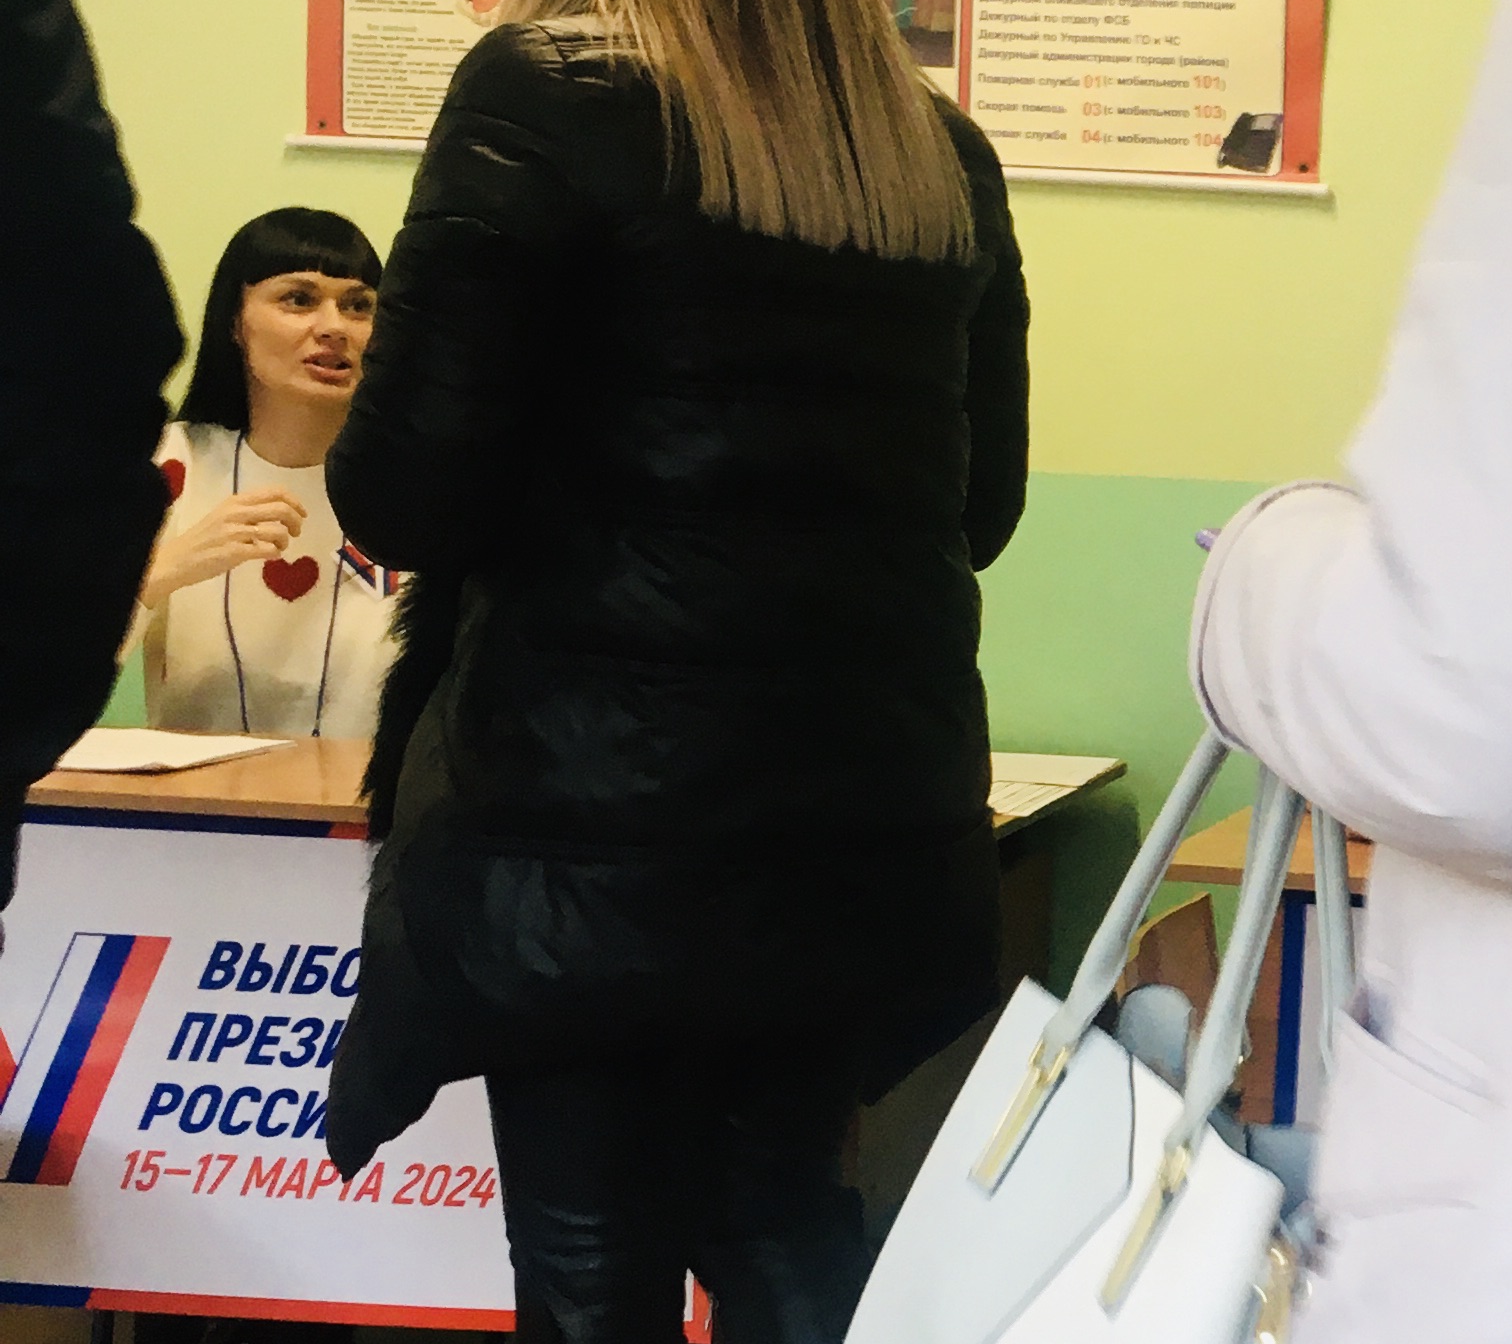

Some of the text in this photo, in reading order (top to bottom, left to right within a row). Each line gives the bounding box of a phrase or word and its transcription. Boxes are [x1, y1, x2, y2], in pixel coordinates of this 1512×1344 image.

[1081, 101, 1102, 117] 03
[1081, 129, 1102, 145] 04
[197, 940, 362, 998] ВЫБО
[137, 1082, 329, 1140] РОССИ
[392, 1162, 496, 1209] 2024
